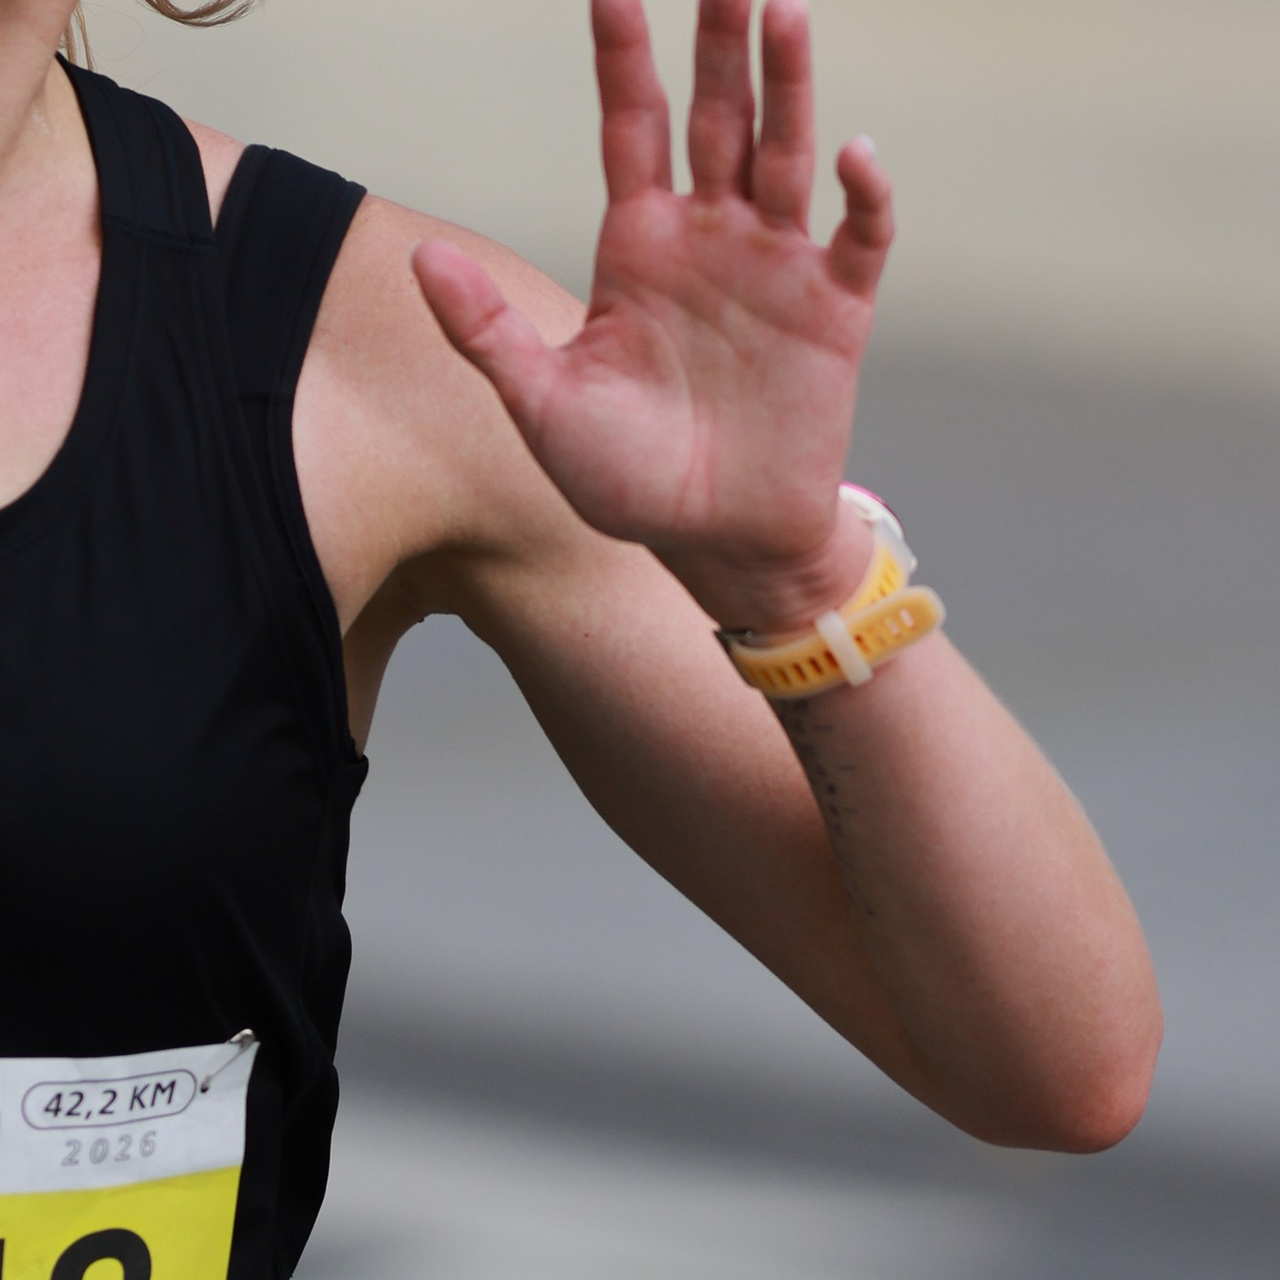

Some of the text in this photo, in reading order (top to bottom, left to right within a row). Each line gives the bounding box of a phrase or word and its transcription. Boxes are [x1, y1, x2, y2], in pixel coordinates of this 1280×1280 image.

[43, 1079, 176, 1120] 42,2 КМ
[61, 1130, 158, 1167] 2026
